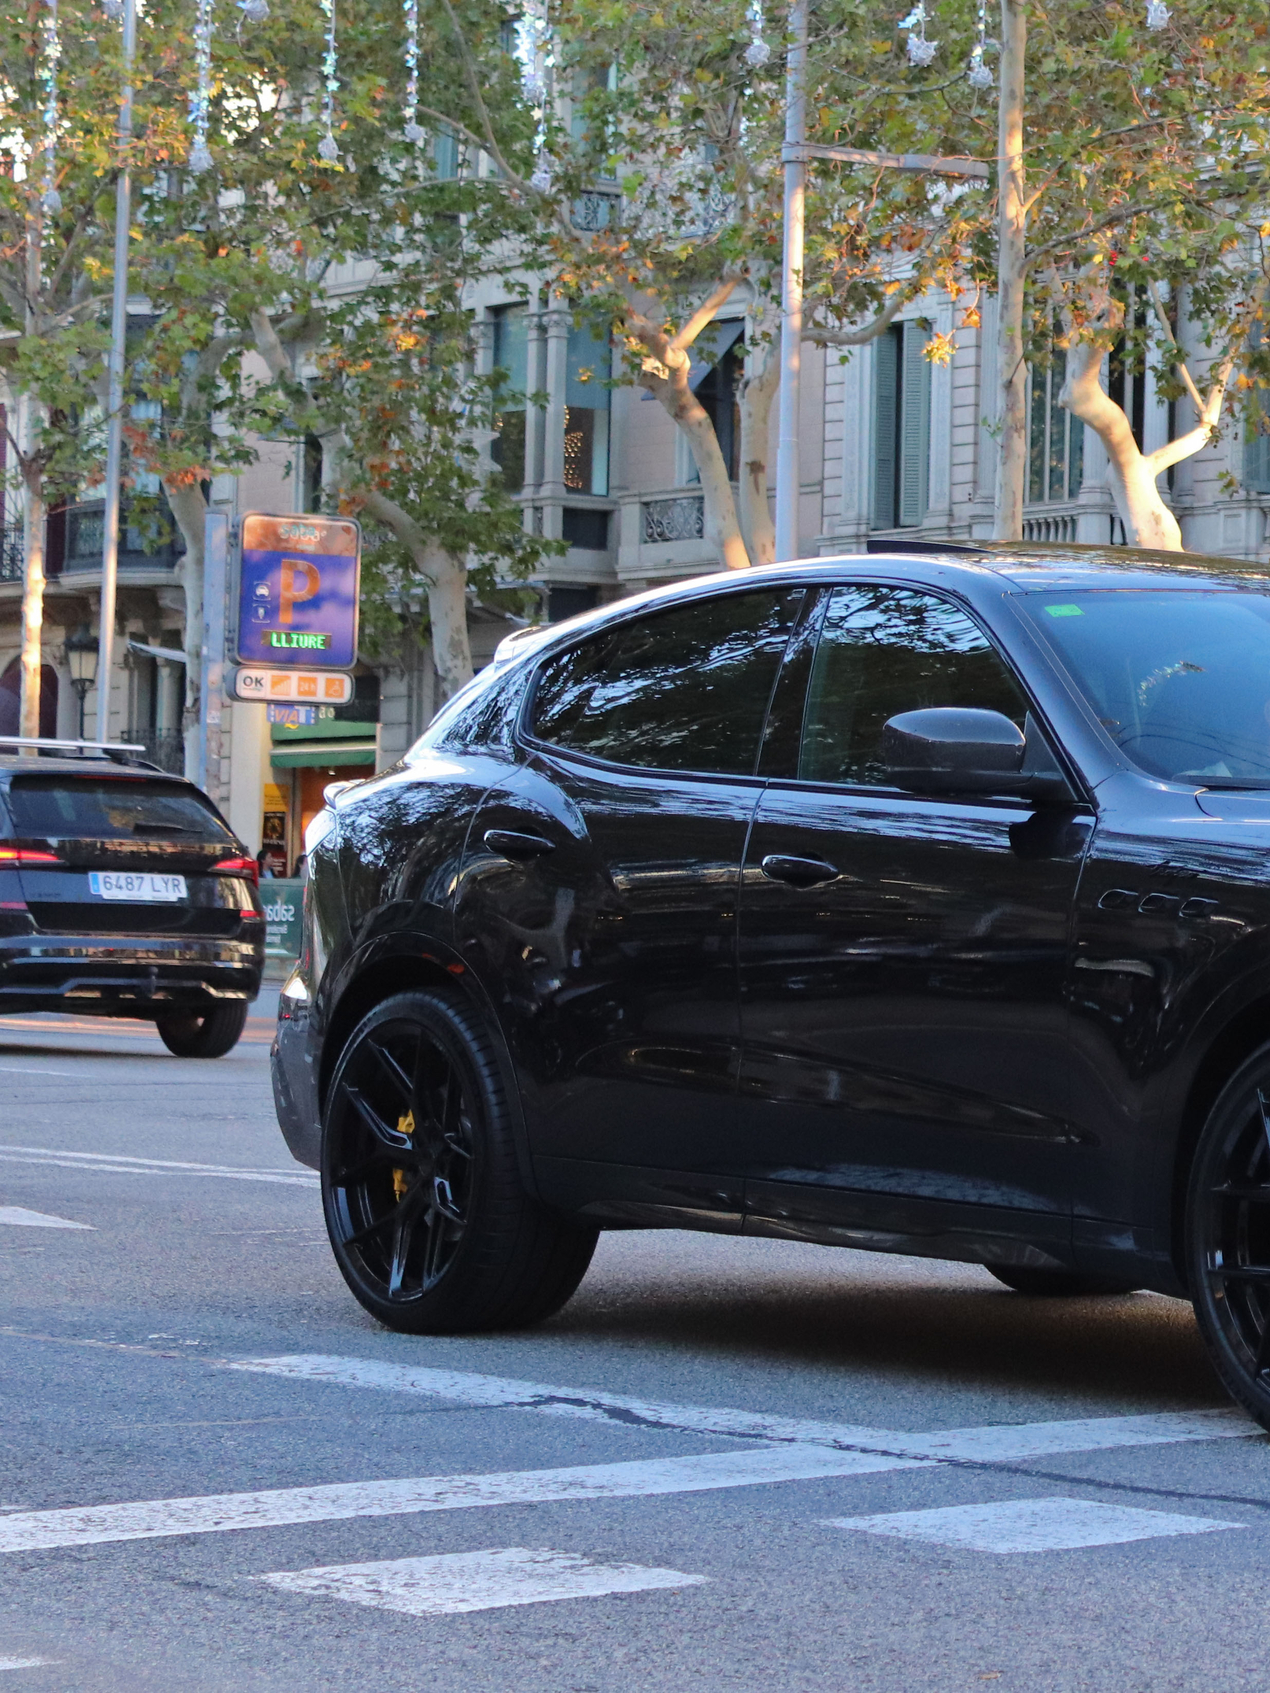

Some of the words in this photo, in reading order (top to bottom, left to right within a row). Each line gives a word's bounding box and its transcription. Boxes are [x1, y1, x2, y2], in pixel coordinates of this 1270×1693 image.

[279, 559, 320, 624] P
[271, 632, 326, 649] LLIURE
[243, 676, 264, 688] OK
[103, 875, 144, 892] 6487
[150, 876, 182, 894] LYR
